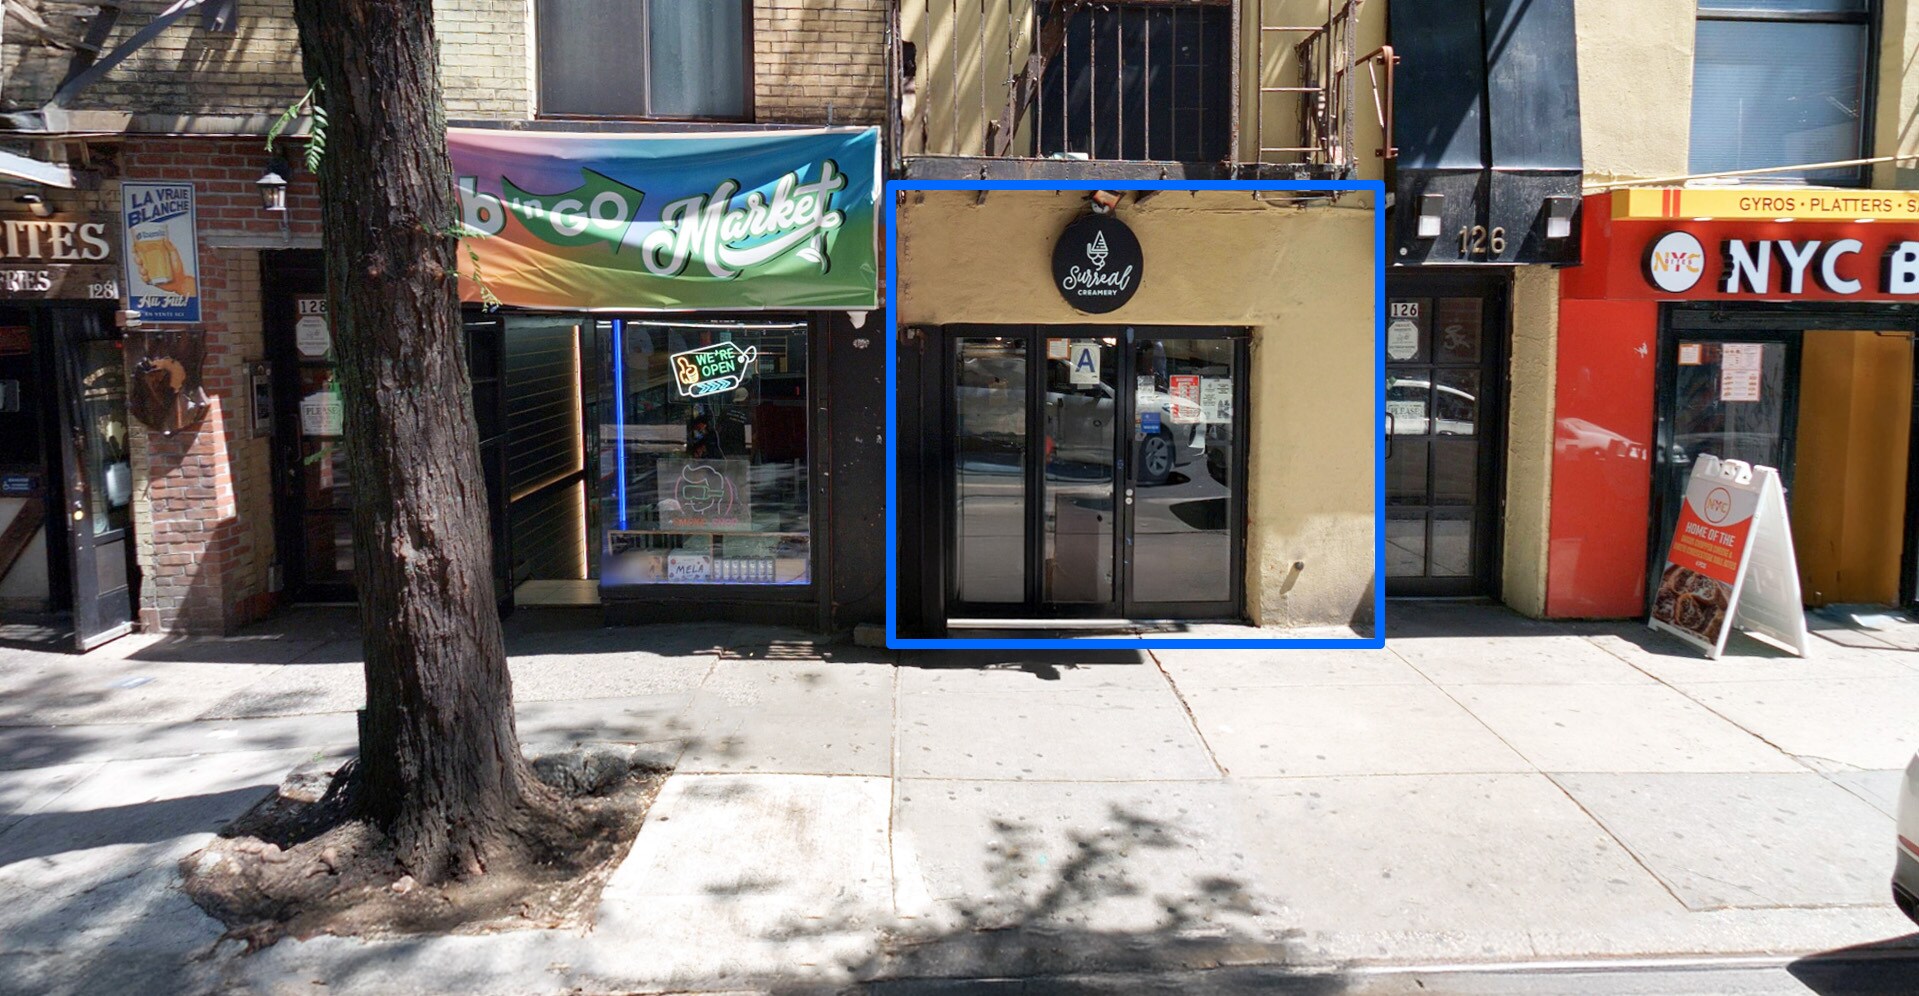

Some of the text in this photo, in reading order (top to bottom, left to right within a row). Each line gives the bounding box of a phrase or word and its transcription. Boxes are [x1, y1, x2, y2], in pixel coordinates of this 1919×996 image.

[131, 188, 189, 210] LA VRAIE
[1739, 196, 1795, 211] GYROS
[1809, 197, 1893, 213] PLATTERS
[127, 200, 190, 229] BLANCHE
[641, 160, 845, 277] Market
[0, 219, 110, 260] ITES
[1459, 225, 1506, 254] 126
[1653, 251, 1701, 273] NYC
[1725, 238, 1864, 295] NYC
[1062, 264, 1134, 291] Surreal
[1077, 289, 1118, 297] CREAMERY
[301, 300, 328, 314] 128
[1393, 303, 1418, 317] 126
[695, 347, 735, 366] WE'RE
[1075, 347, 1096, 373] A
[701, 359, 736, 377] OPEN
[1686, 522, 1708, 539] HOME
[1708, 529, 1719, 542] OF
[1719, 532, 1735, 547] THE
[676, 564, 704, 575] MELA
